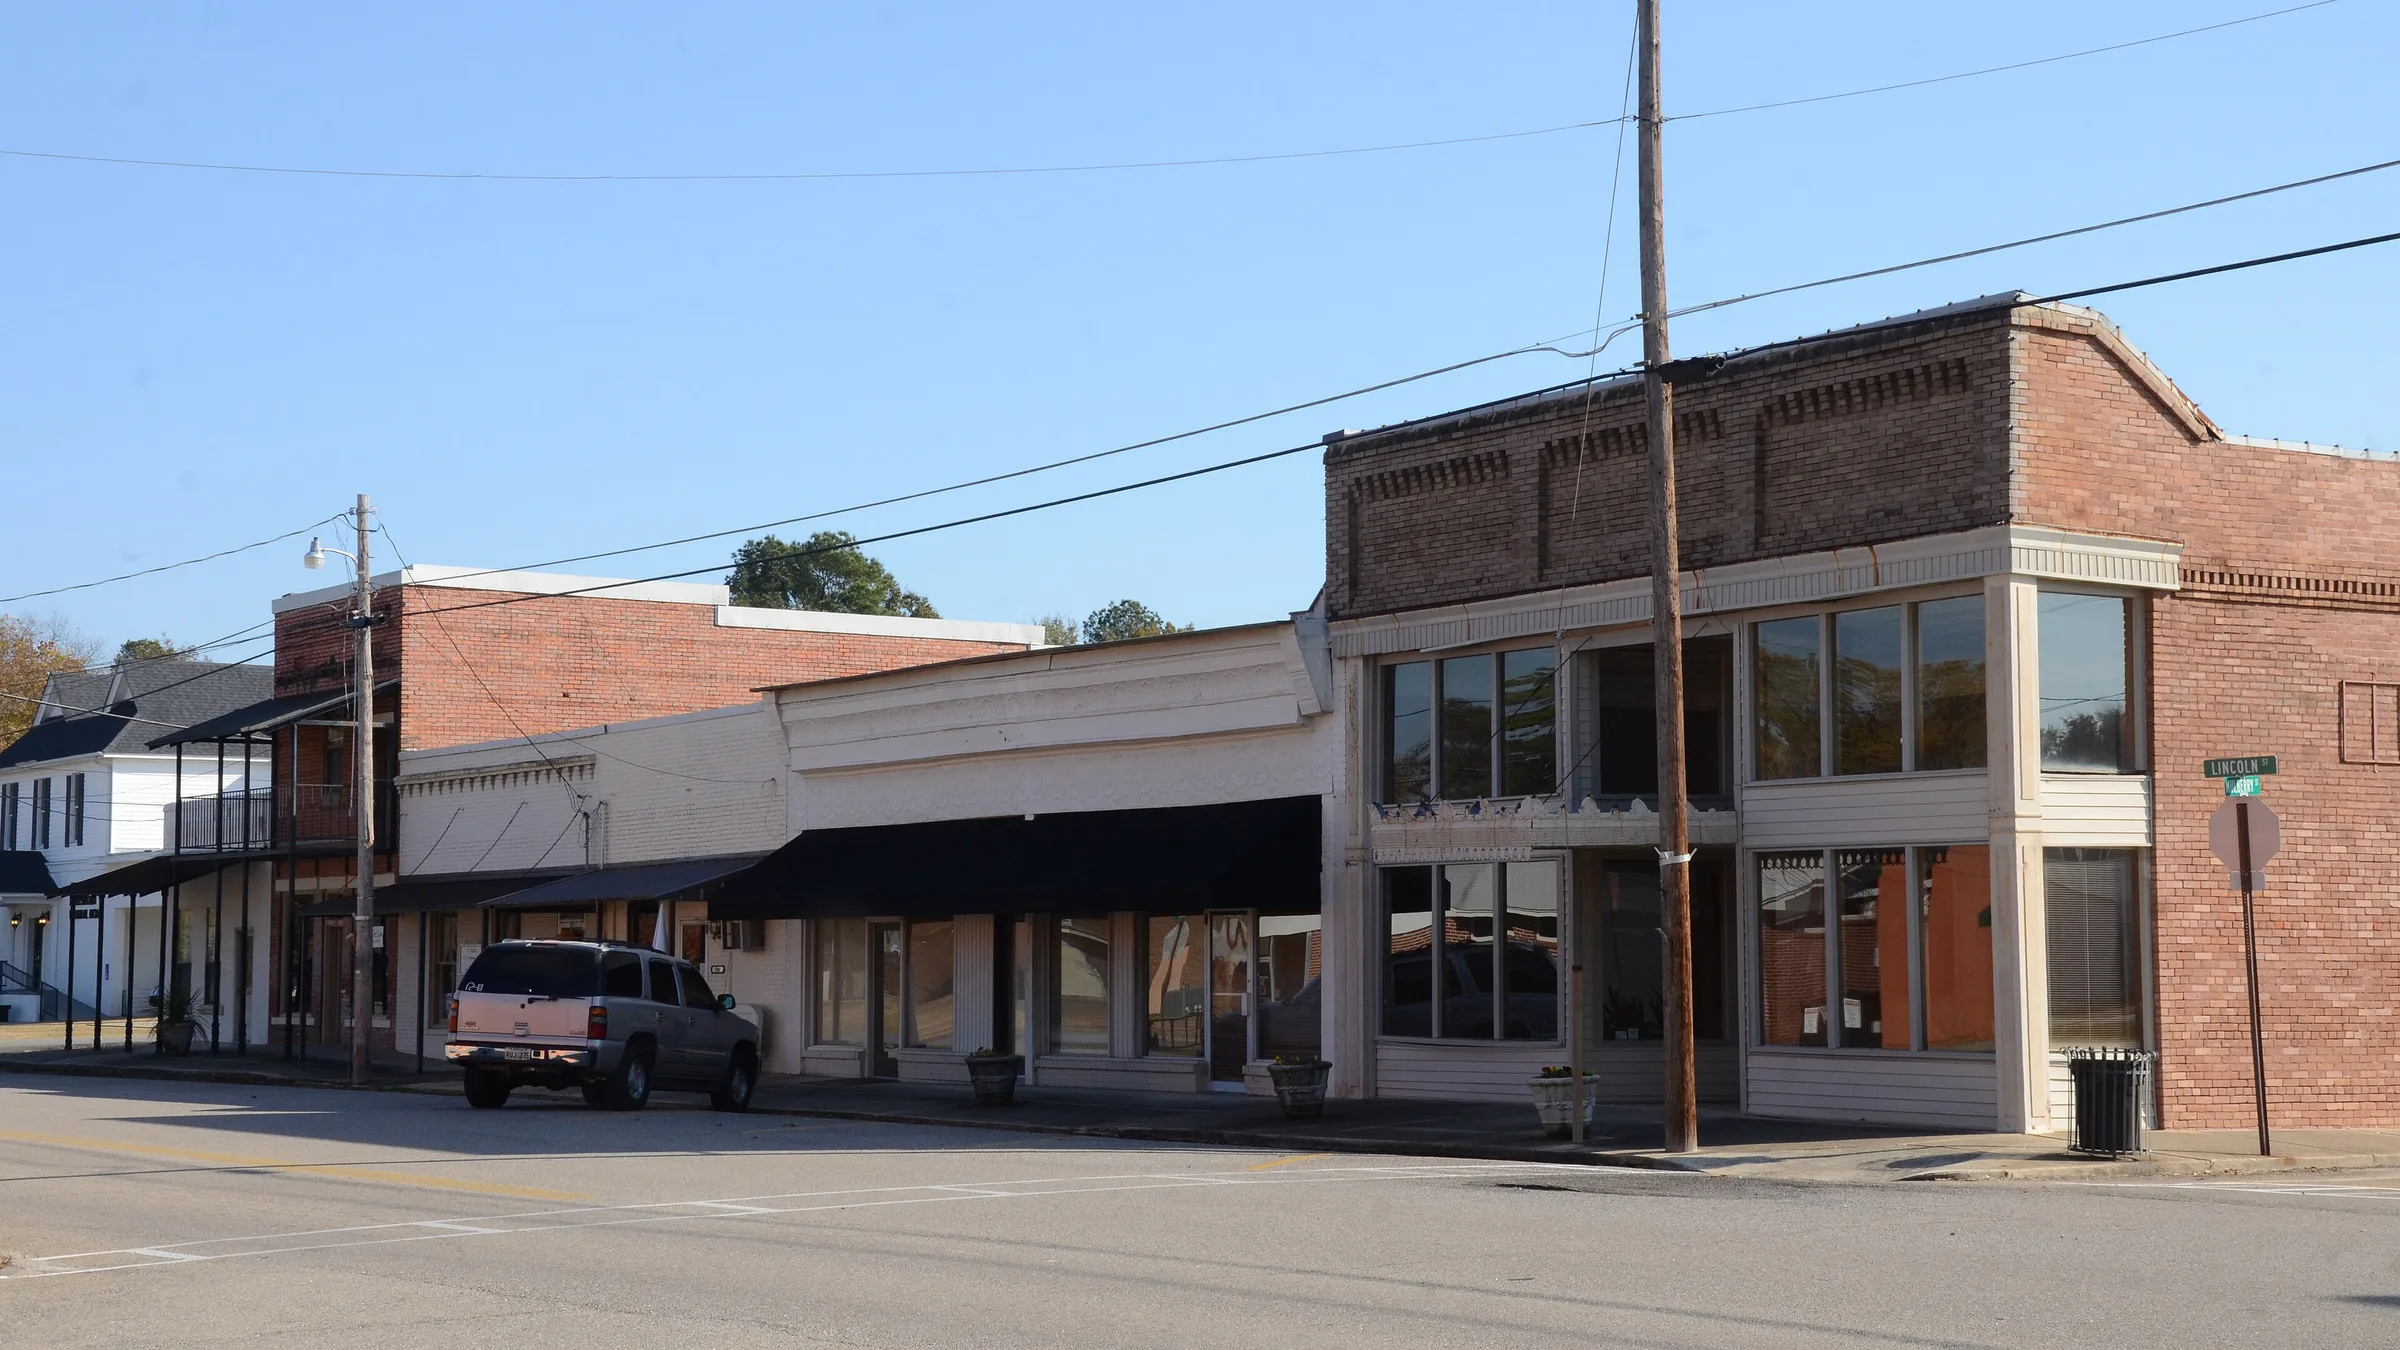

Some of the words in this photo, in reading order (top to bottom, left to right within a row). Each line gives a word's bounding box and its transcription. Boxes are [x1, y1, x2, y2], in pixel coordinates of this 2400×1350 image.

[2211, 759, 2258, 775] LINCOLN
[2262, 758, 2268, 766] ST
[2226, 778, 2254, 793] MULBERRY
